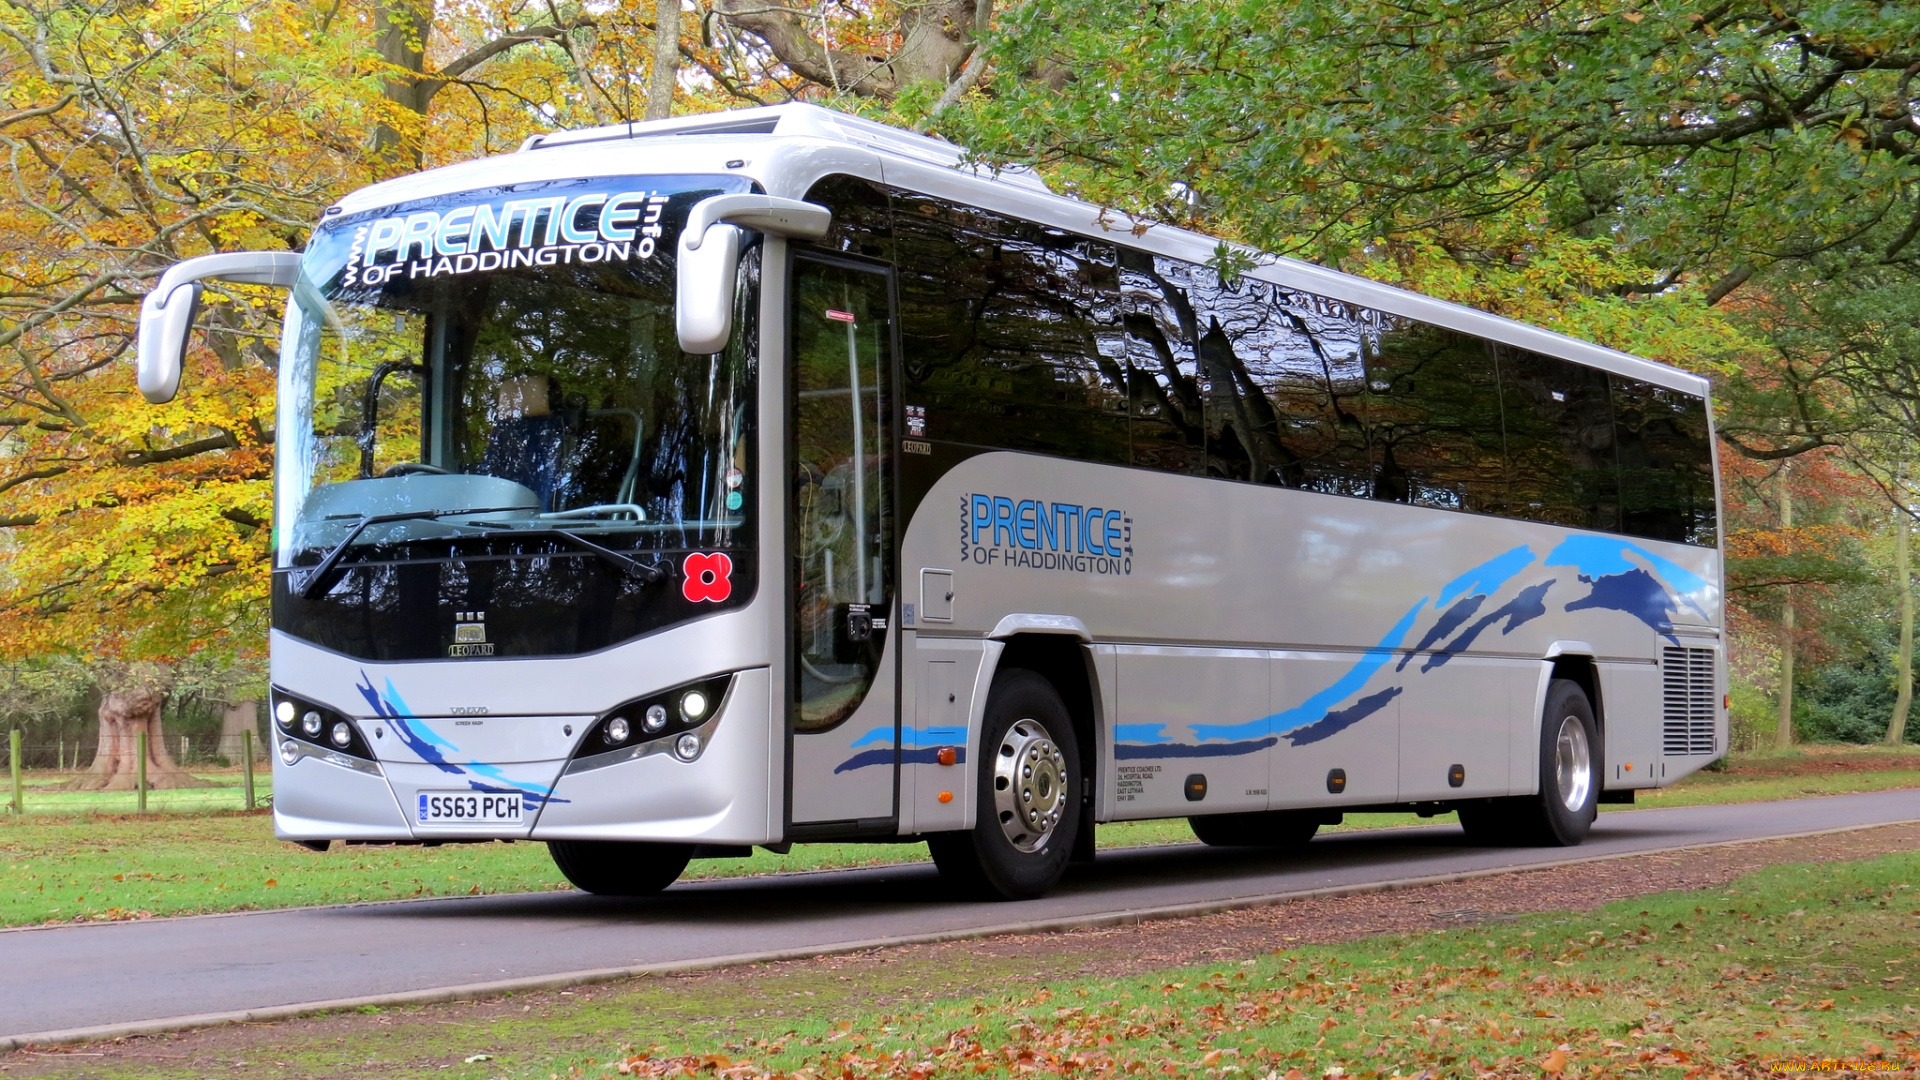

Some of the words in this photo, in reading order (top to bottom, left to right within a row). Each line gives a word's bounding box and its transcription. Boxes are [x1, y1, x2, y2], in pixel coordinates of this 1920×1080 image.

[363, 191, 645, 267] PRENTICE
[362, 262, 403, 286] OF
[410, 242, 632, 280] HADDINGTON
[902, 440, 931, 455] LEOPARD
[971, 493, 1122, 558] PRENTICE
[973, 547, 999, 565] OF
[1004, 549, 1121, 576] HADDINGTON
[449, 643, 495, 657] LEOPARD
[450, 706, 489, 715] VOLVO
[431, 797, 477, 818] SS63
[483, 797, 519, 818] PCH
